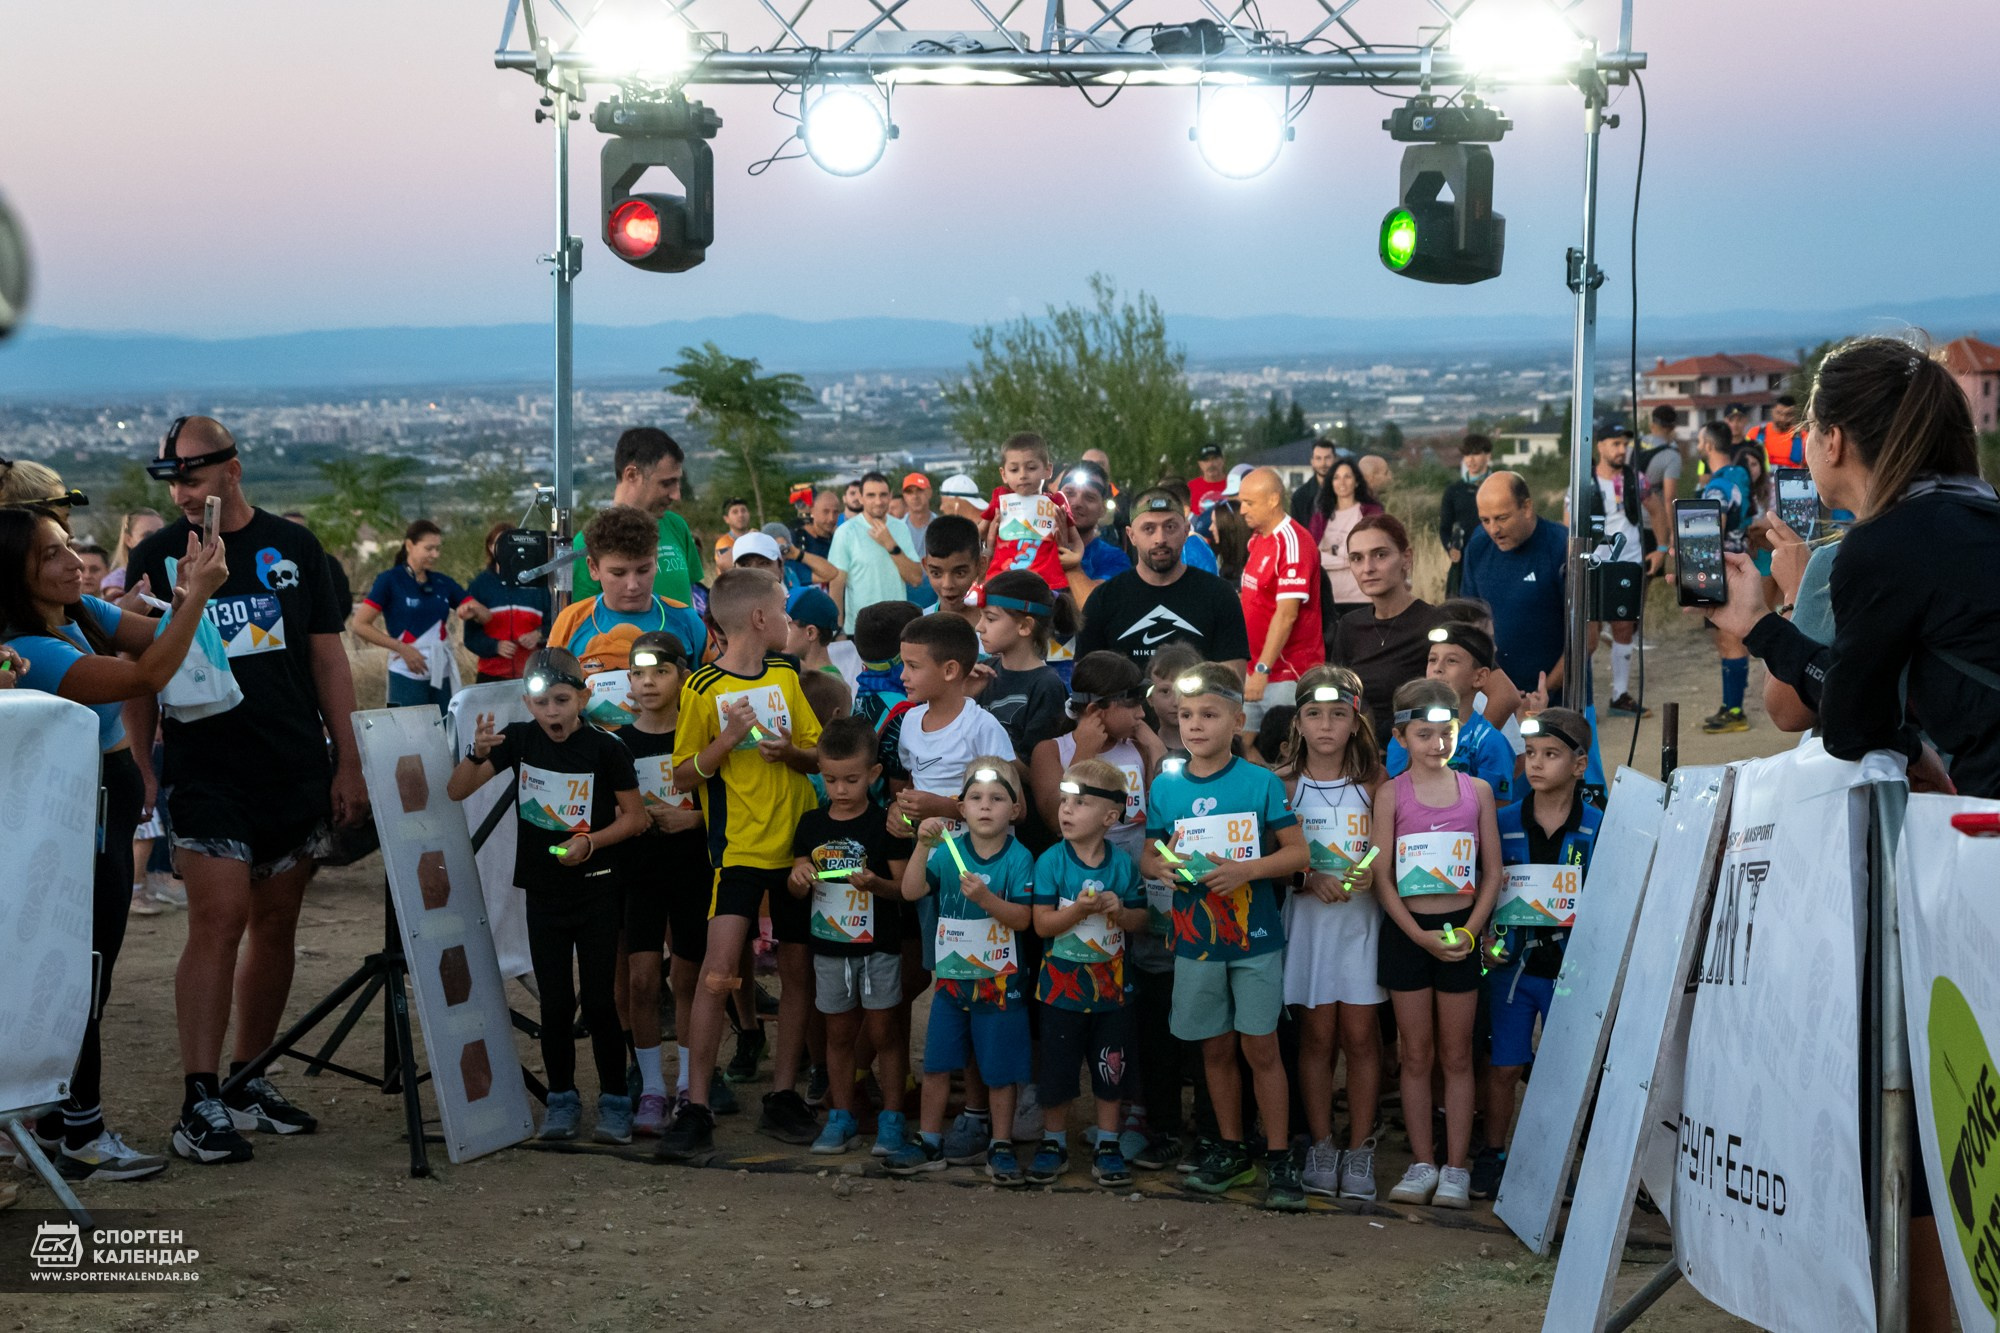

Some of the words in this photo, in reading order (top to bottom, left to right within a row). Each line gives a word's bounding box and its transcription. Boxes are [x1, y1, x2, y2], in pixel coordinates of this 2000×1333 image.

[1036, 499, 1056, 518] 68
[1033, 519, 1052, 529] KIDS
[768, 690, 784, 713] 42
[768, 715, 786, 729] KIDS
[660, 761, 672, 782] 5
[1128, 771, 1140, 792] 2
[568, 780, 589, 801] 74
[1127, 795, 1140, 807] DS
[557, 804, 586, 816] KIDS
[947, 820, 961, 831] DS
[1227, 819, 1254, 843] 82
[1347, 814, 1369, 836] 50
[1225, 846, 1253, 859] KIDS
[1344, 840, 1368, 852] KIDS
[1452, 839, 1472, 861] 47
[828, 858, 862, 869] PARK
[1446, 865, 1470, 877] KIDS
[1552, 871, 1577, 894] 48
[845, 890, 869, 911] 79
[1547, 898, 1575, 910] KIDS
[840, 915, 867, 927] KIDS
[987, 924, 1010, 945] 43
[1102, 931, 1121, 947] KIDS
[983, 947, 1010, 962] KIDS
